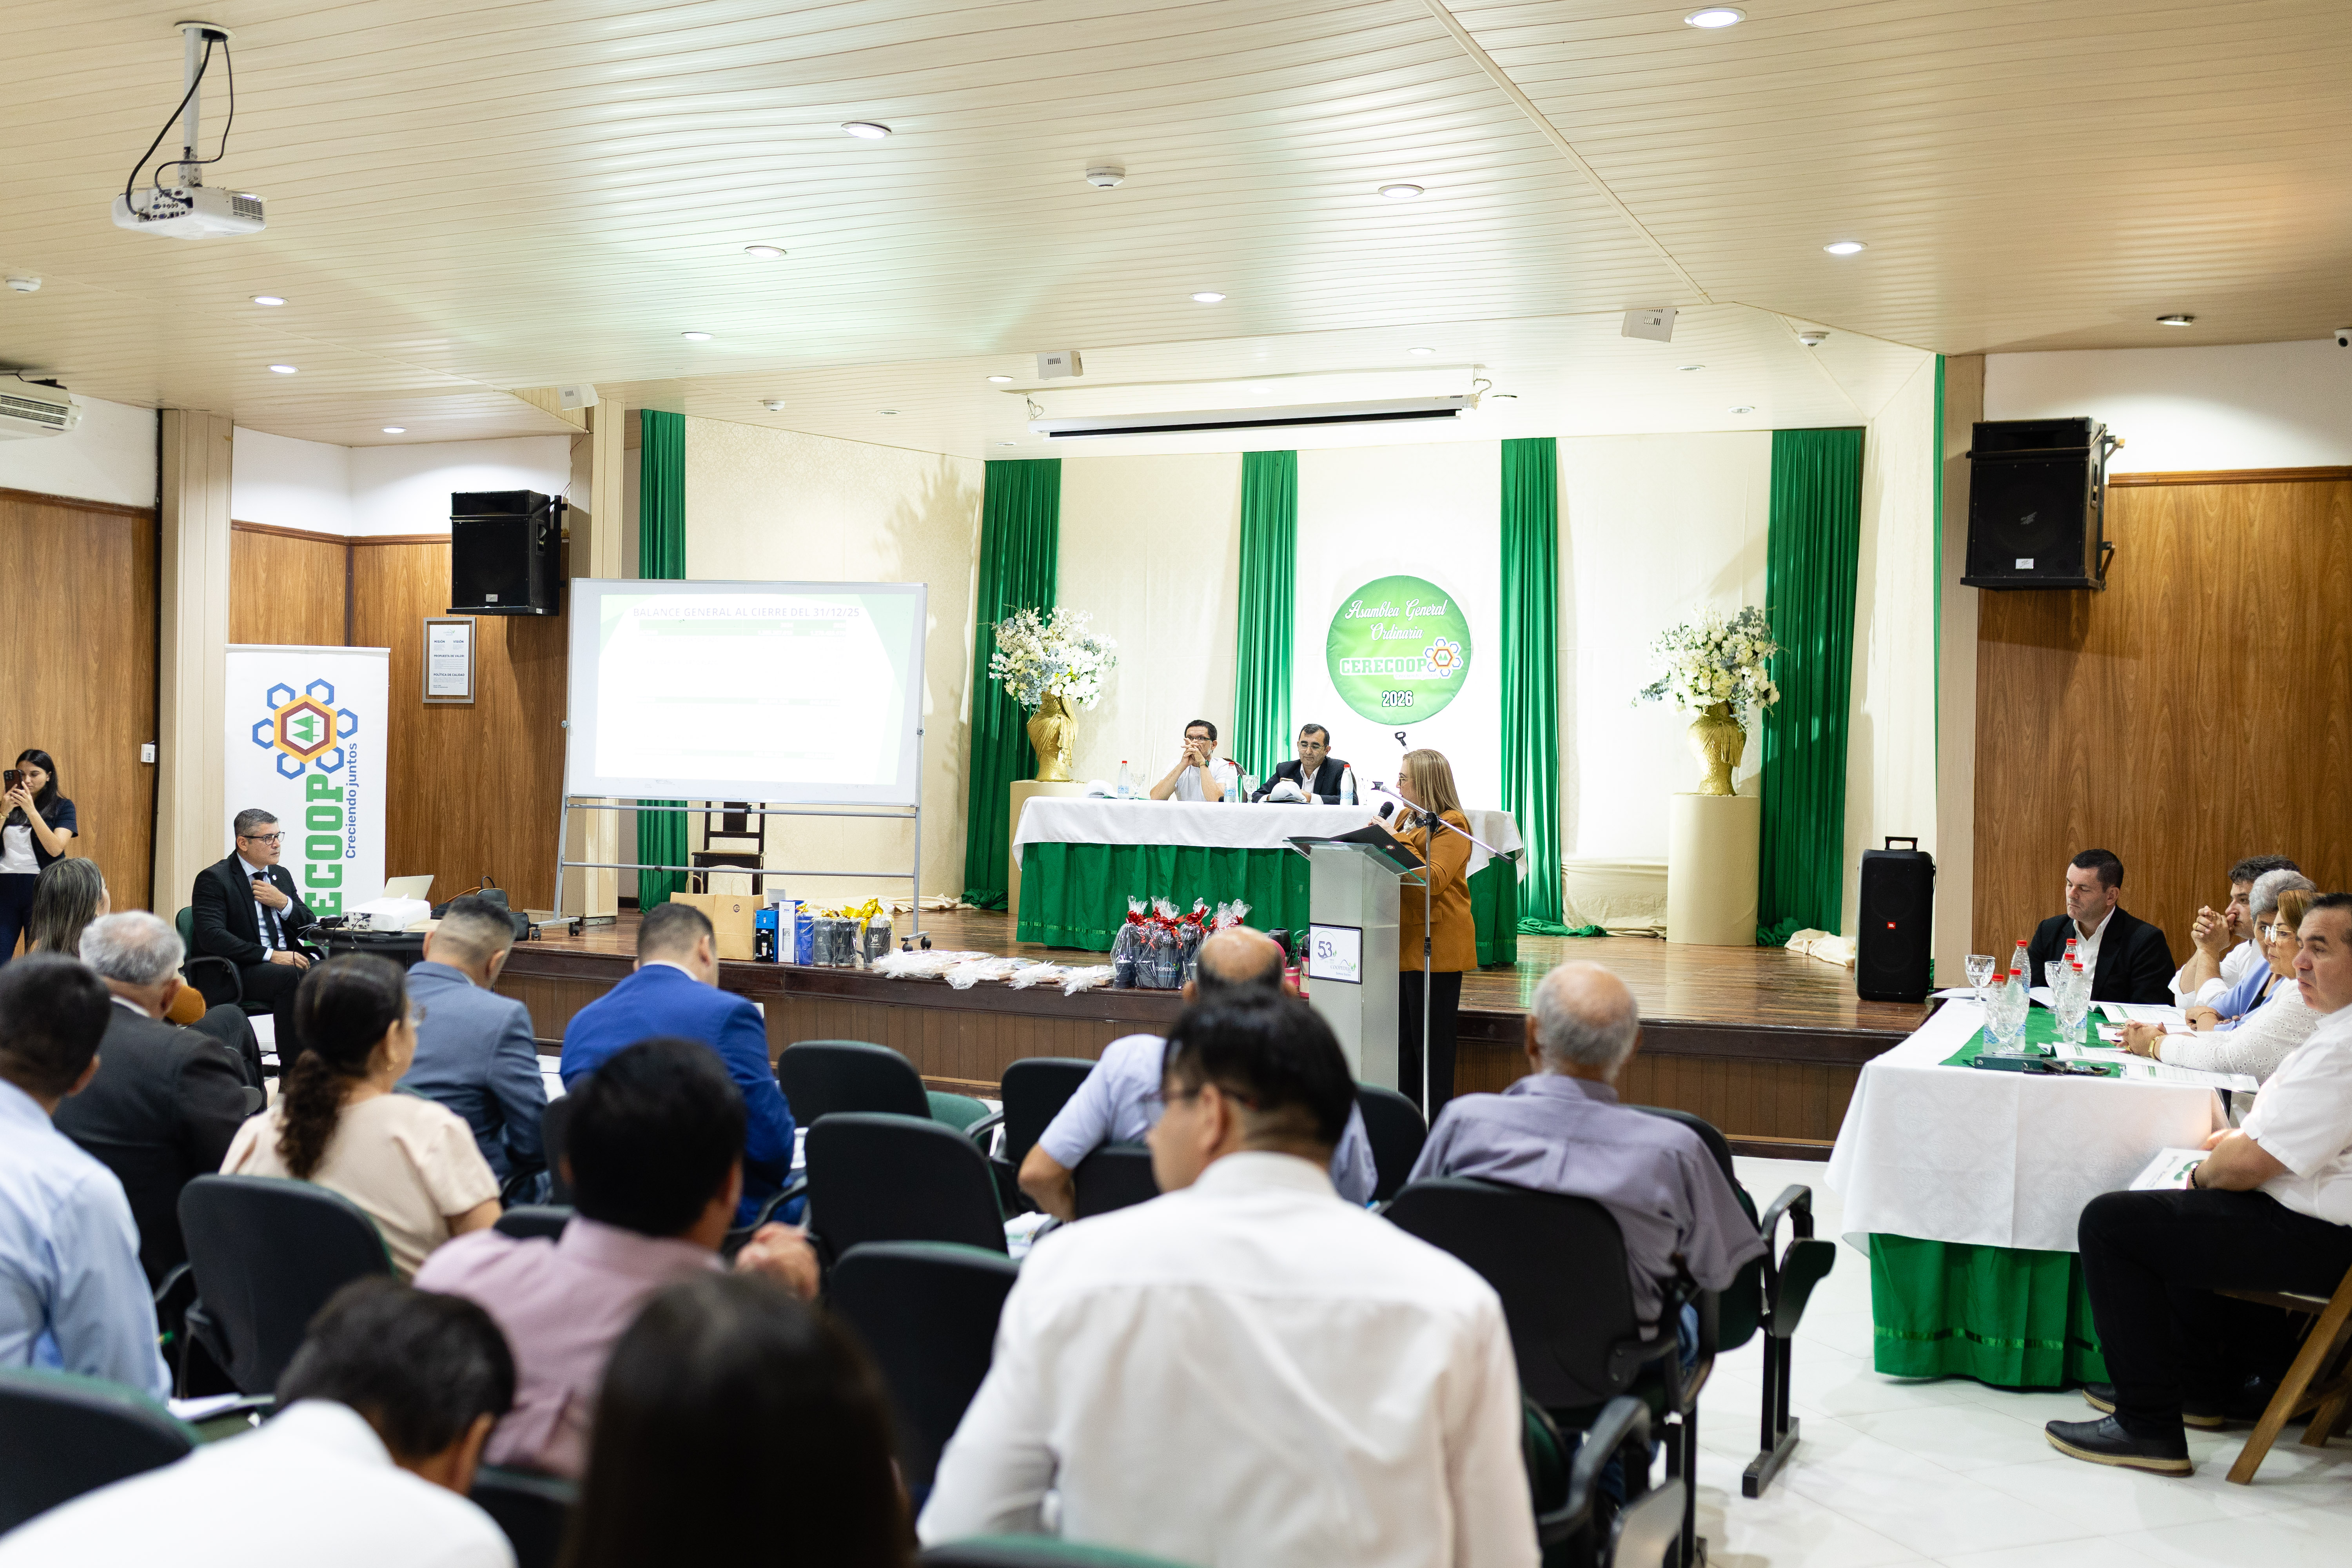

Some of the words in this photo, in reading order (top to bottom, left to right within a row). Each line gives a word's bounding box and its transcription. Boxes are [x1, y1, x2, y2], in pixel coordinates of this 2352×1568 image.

[813, 608, 859, 617] 31/12/25
[1345, 600, 1401, 619] Asamblea
[1405, 599, 1448, 621] General
[1370, 622, 1424, 641] Ordinaria
[1341, 658, 1427, 673] CERECOOP
[1382, 690, 1414, 707] 2026
[346, 743, 359, 787] juntos
[345, 789, 357, 858] Creciendo
[1318, 941, 1332, 958] 53
